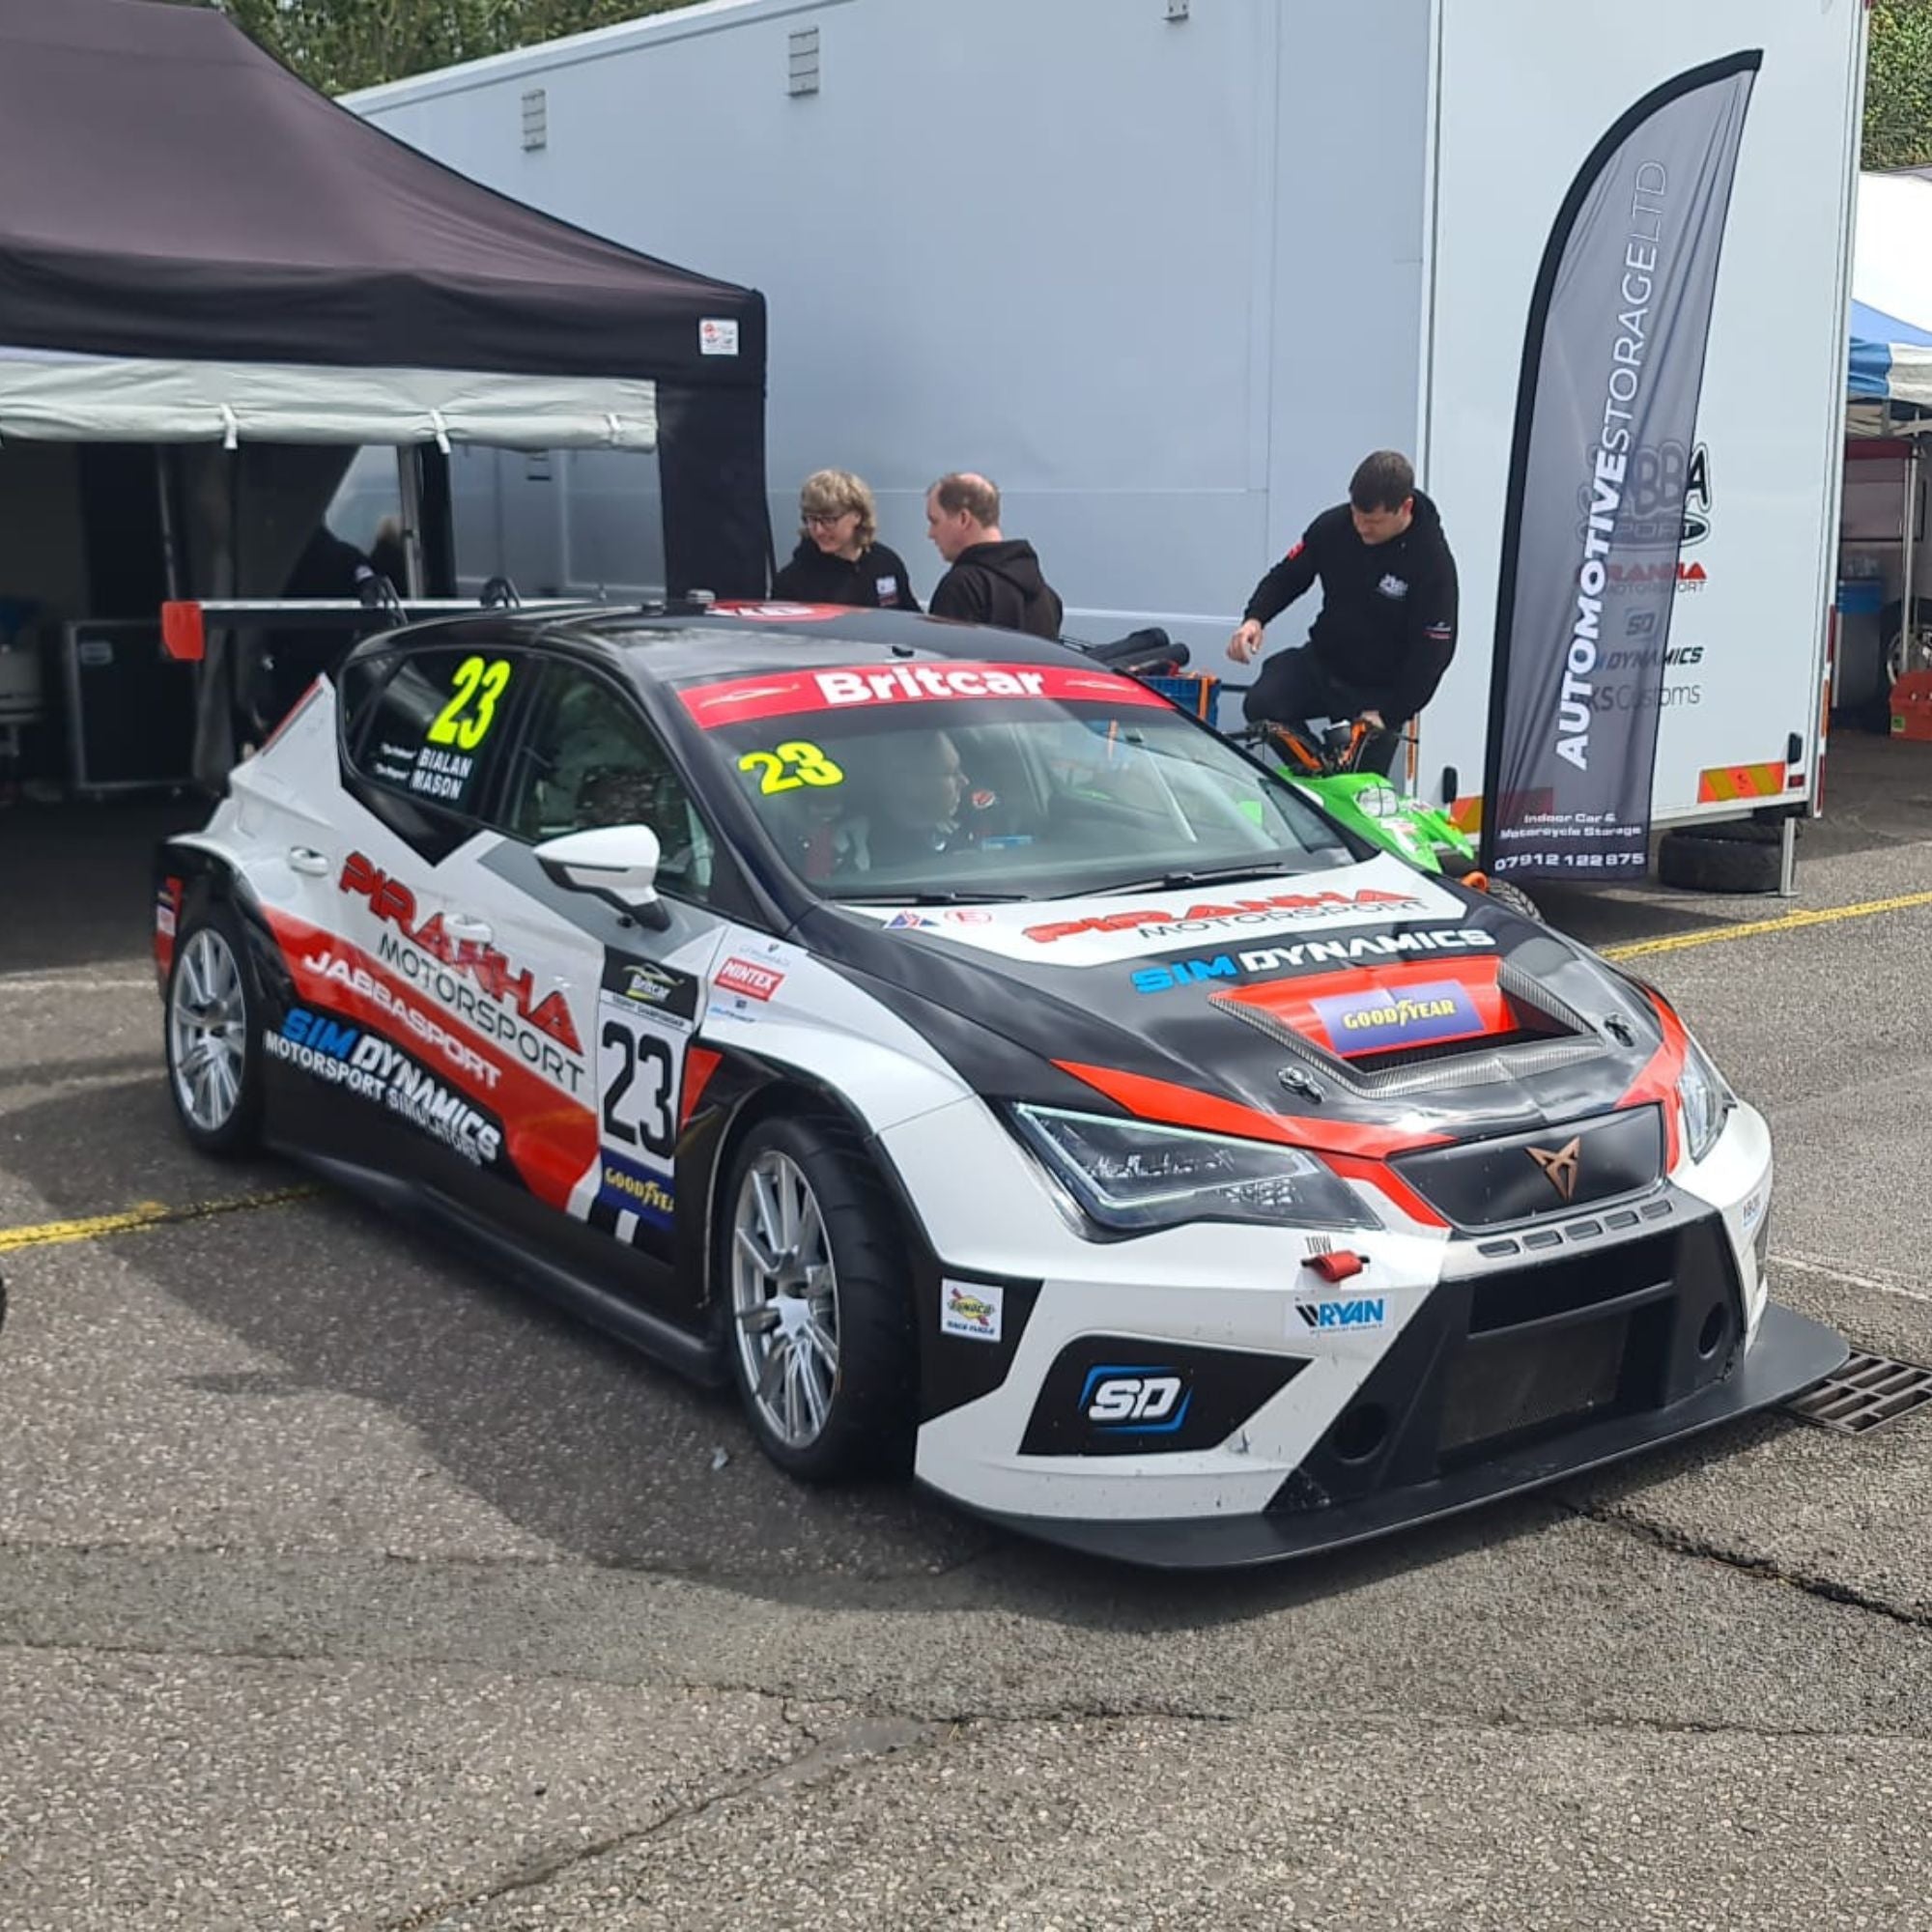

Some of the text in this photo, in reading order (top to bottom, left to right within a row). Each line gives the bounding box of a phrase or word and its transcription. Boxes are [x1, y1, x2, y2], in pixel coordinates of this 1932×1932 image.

[427, 656, 511, 750] 23
[813, 667, 1046, 706] Britcar
[409, 769, 464, 800] MASON
[416, 747, 473, 778] BIALAN
[737, 740, 844, 795] 23
[1499, 825, 1642, 839] Motorcycle Storage
[1523, 813, 1574, 824] Indoor
[1575, 812, 1604, 823] Car
[1493, 852, 1646, 871] 07912 122 875
[1021, 888, 1423, 944] PIRANHA
[1137, 900, 1430, 939] MOTORSPORT
[1130, 928, 1496, 995] SIM DYNAMICS
[302, 952, 502, 1090] JABBASPORT
[378, 933, 586, 1094] MOTORSPORT
[1343, 998, 1457, 1030] GOODYEAR
[265, 1031, 384, 1101] MOTORSPORT
[281, 1008, 501, 1161] SIM DYNAMICS
[602, 1020, 674, 1160] 23
[605, 1166, 674, 1212] GOODYE
[1089, 1376, 1181, 1422] SD
